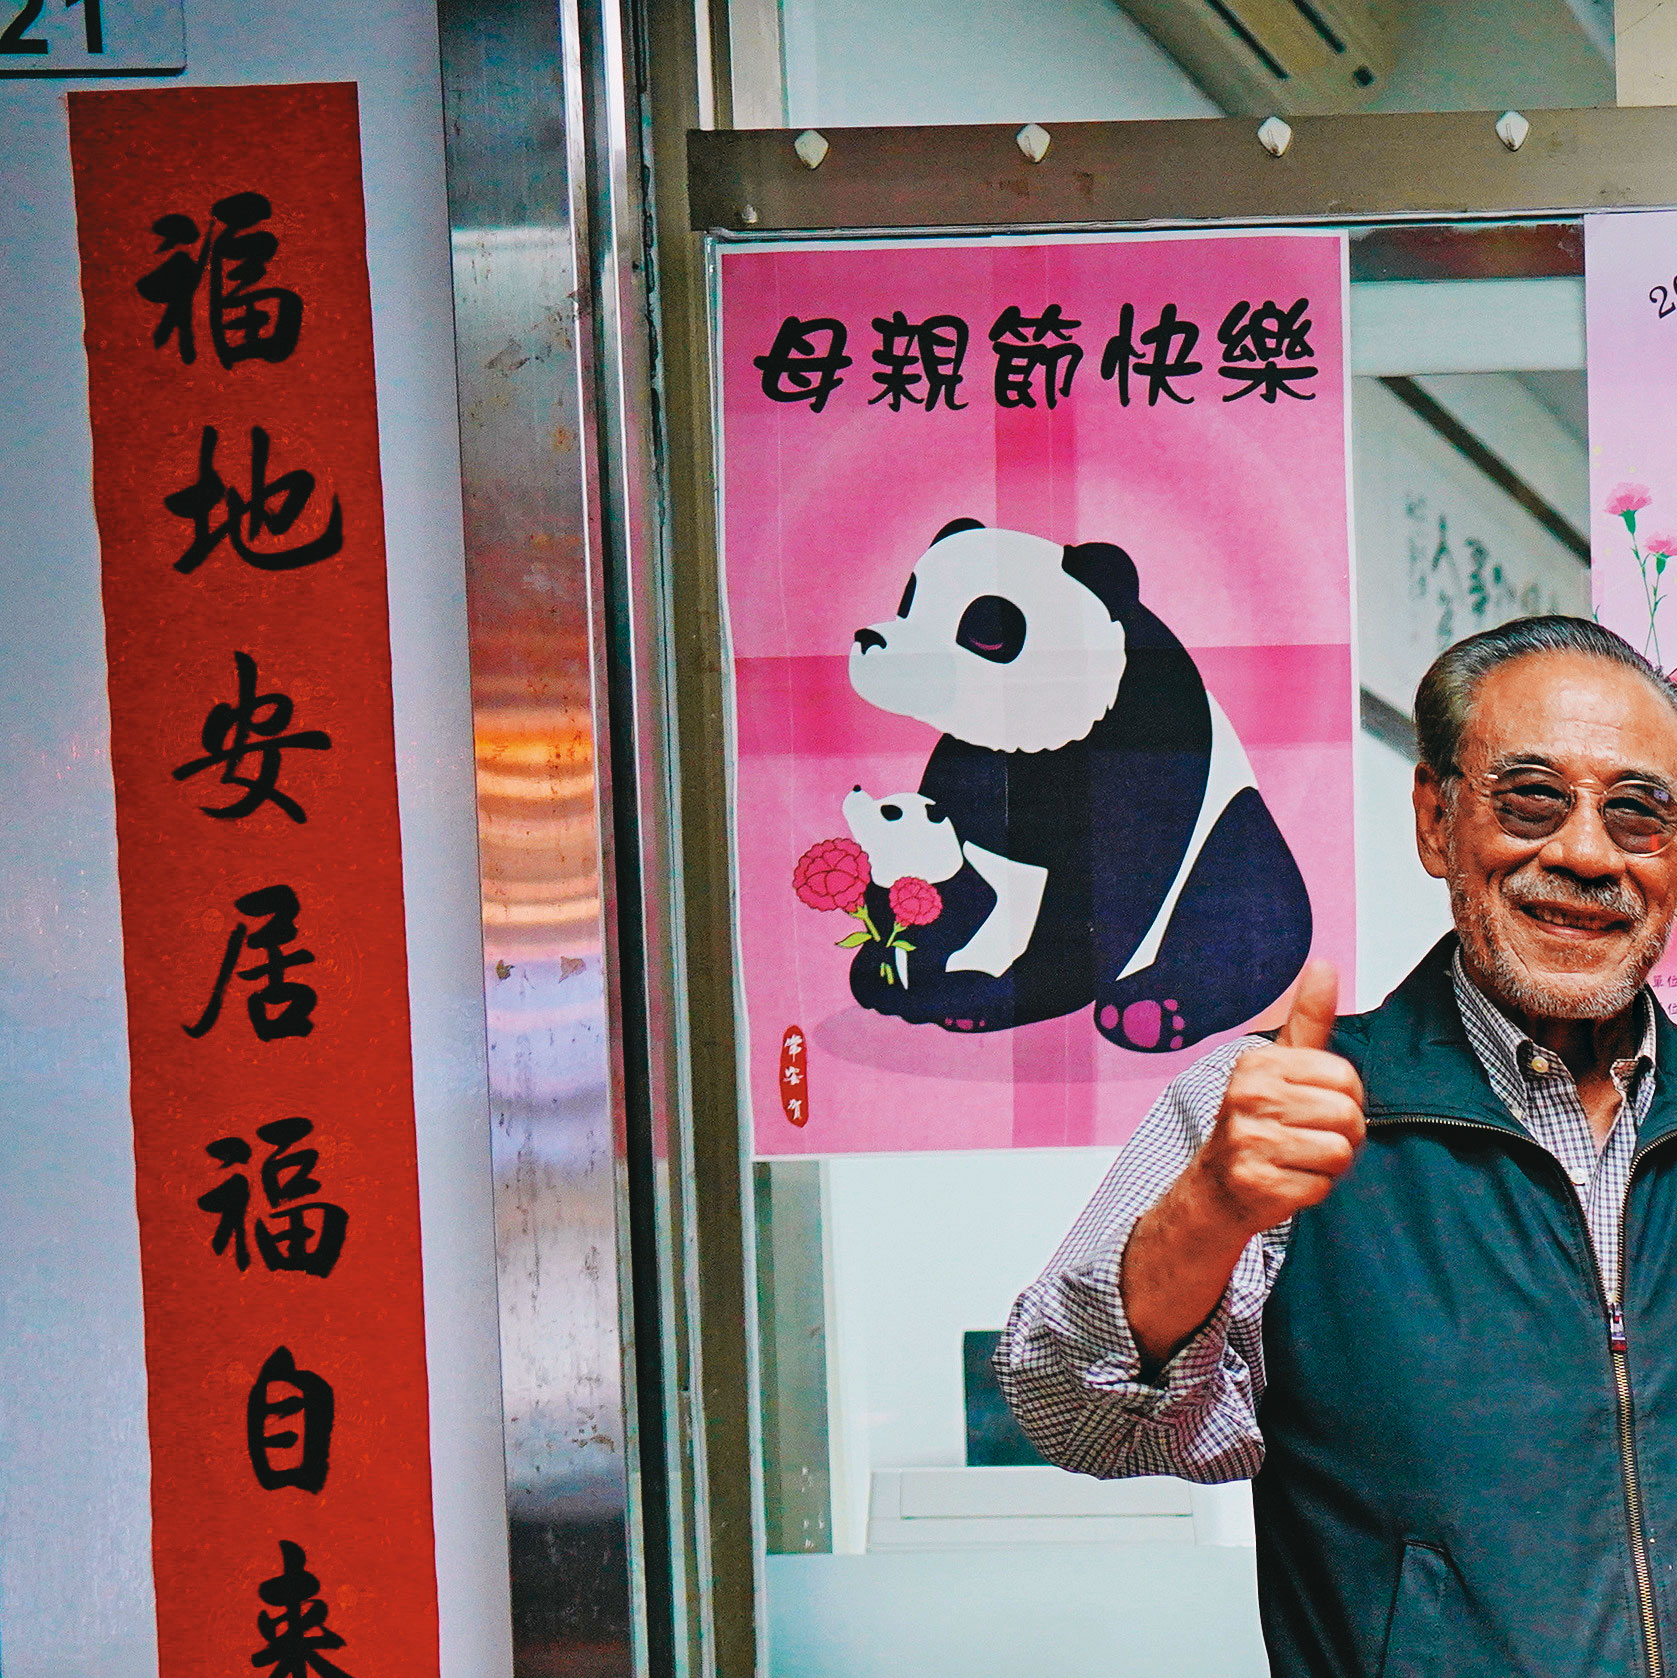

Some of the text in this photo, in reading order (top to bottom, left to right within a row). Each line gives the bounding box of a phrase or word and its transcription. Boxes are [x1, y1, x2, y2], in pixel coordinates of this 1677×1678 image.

[752, 296, 1319, 413] 母親節快樂
